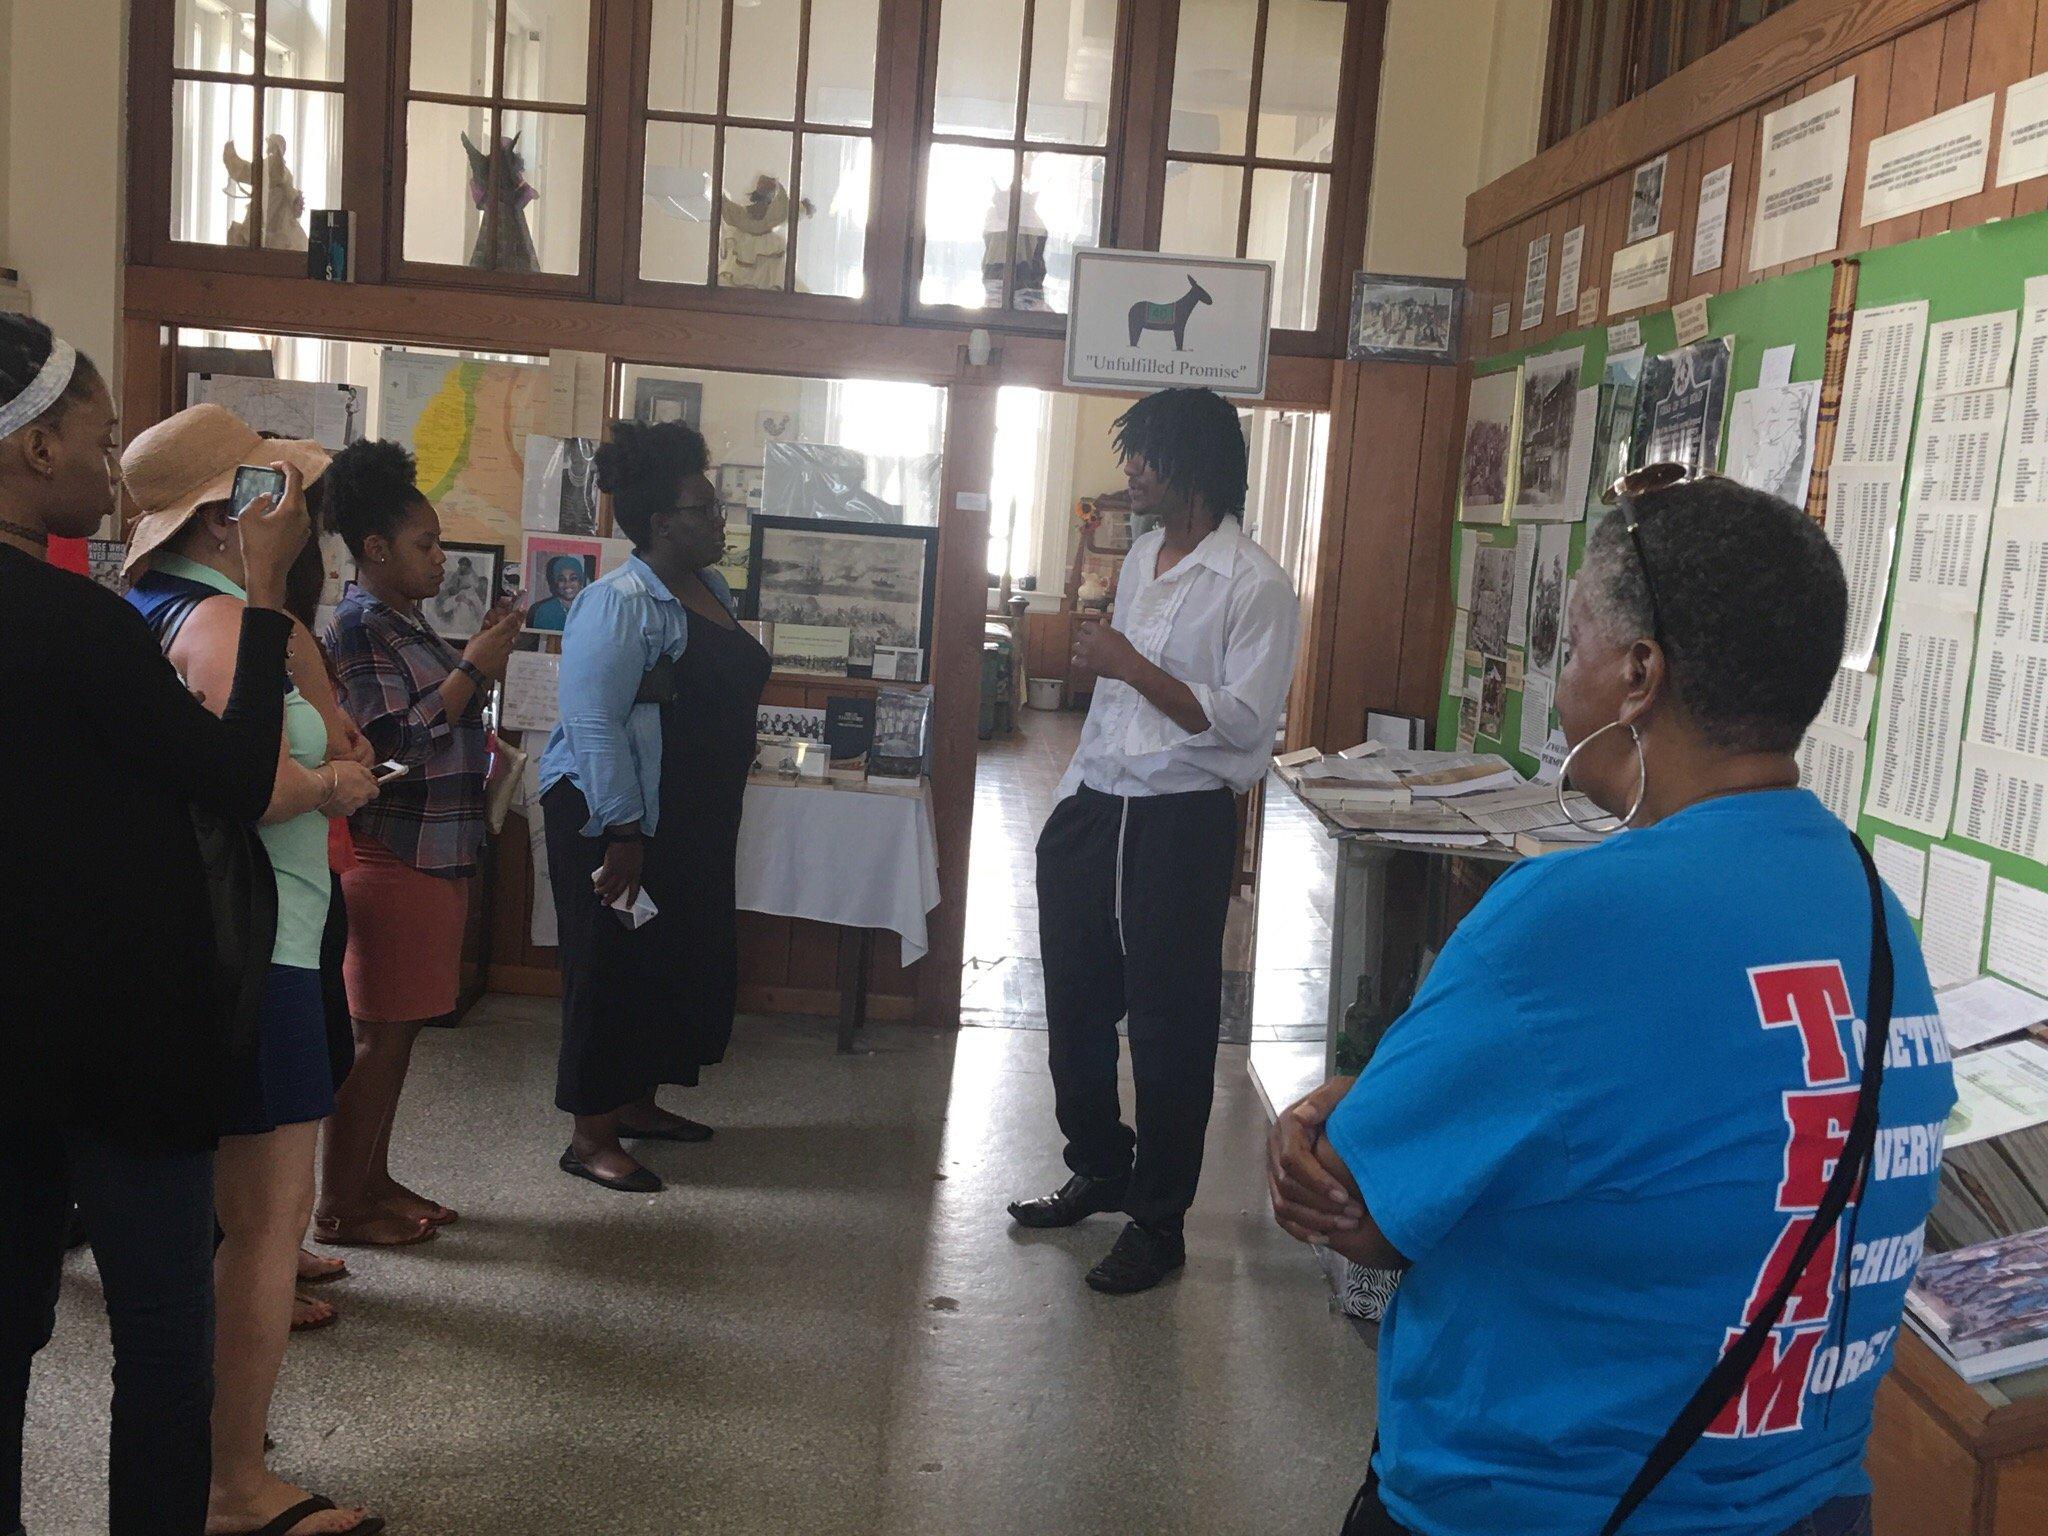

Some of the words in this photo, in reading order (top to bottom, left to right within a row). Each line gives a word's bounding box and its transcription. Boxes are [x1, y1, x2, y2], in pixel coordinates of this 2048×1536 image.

[325, 265, 333, 281] S
[1086, 354, 1174, 374] "Unfulfilled
[1180, 361, 1247, 379] Promise"
